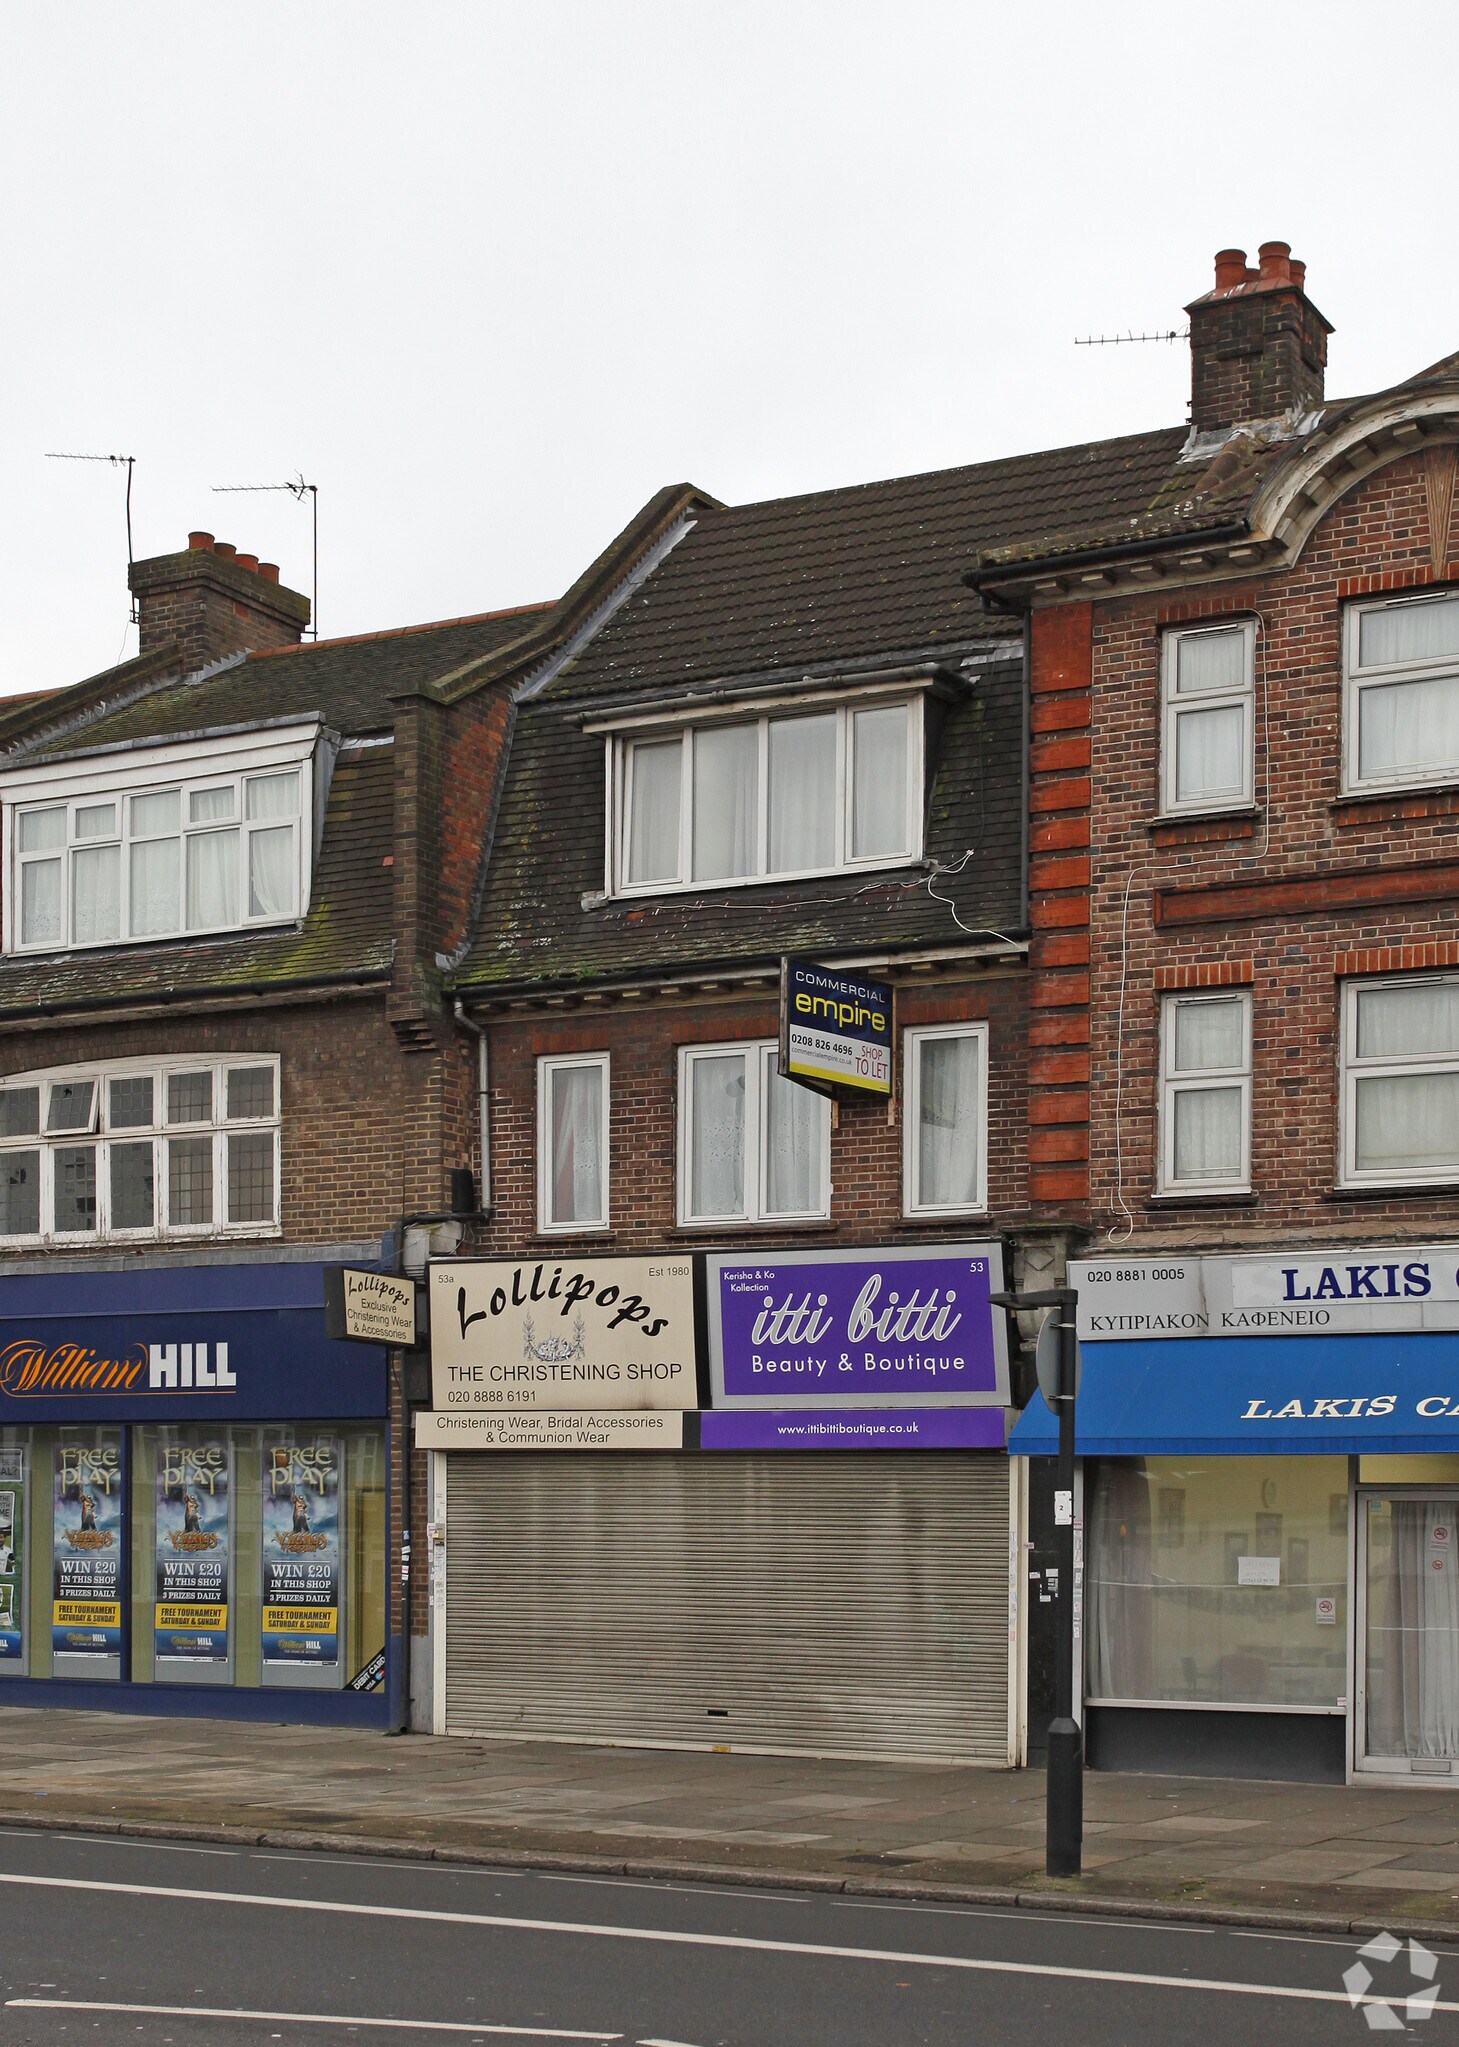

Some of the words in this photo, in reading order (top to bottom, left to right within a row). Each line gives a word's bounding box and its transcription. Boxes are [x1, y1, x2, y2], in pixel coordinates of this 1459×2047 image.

[795, 971, 885, 1003] COMMERCIAL
[795, 993, 885, 1031] empire
[791, 1033, 813, 1047] 0208
[815, 1039, 831, 1051] 826
[832, 1043, 853, 1056] 4696
[861, 1045, 883, 1060] SHOP
[855, 1057, 869, 1076] TO
[872, 1062, 888, 1080] LET
[648, 1267, 664, 1277] Est
[667, 1266, 690, 1276] 1980
[970, 1262, 984, 1273] 53
[438, 1274, 455, 1284] 53a
[723, 1271, 753, 1280] Kerisha
[755, 1270, 762, 1279] &
[764, 1270, 775, 1279] Ko
[1087, 1271, 1112, 1283] 020
[1116, 1269, 1147, 1282] 8881
[1152, 1268, 1185, 1281] 0005
[1281, 1262, 1431, 1302] LAKIS
[349, 1276, 410, 1306] Lollipops
[730, 1282, 769, 1292] Kollection
[361, 1298, 397, 1313] Exclusive
[457, 1264, 669, 1340] Lollipops
[751, 1293, 833, 1346] itti
[847, 1273, 962, 1344] bitti
[347, 1308, 389, 1327] Christening
[391, 1316, 412, 1328] Wear
[1090, 1313, 1210, 1331] ΚΥΠΡΙΑΚΟΝ
[1221, 1310, 1331, 1328] ΚΑΦΕΝΕΙΟ
[353, 1322, 359, 1332] &
[361, 1323, 407, 1339] Accessories
[0, 1340, 148, 1392] William
[149, 1342, 237, 1388] HILL
[751, 1354, 828, 1377] Beauty
[838, 1353, 853, 1371] &
[865, 1352, 965, 1376] Boutique
[448, 1365, 484, 1382] THE
[489, 1364, 621, 1382] CHRISTENING
[627, 1363, 682, 1380] SHOP
[447, 1391, 470, 1403] 020
[473, 1390, 503, 1402] 8888
[507, 1390, 536, 1402] 6191
[1240, 1395, 1398, 1420] LAKIS
[436, 1416, 504, 1431] Christening
[508, 1417, 543, 1430] Wear,
[548, 1416, 583, 1428] Bridal
[587, 1416, 664, 1429] Accessories
[777, 1422, 919, 1436] www.ittibittiboutique.co.uk
[485, 1432, 495, 1443] &
[498, 1432, 573, 1443] Communion
[574, 1432, 610, 1443] Wear
[61, 1448, 118, 1469] FREE
[163, 1448, 223, 1469] FREE
[270, 1446, 332, 1468] FREE
[0, 1467, 17, 1476] AL?
[60, 1465, 119, 1495] PLAY
[163, 1465, 223, 1495] PLAY
[269, 1465, 333, 1495] PLAY
[61, 1560, 91, 1573] WIN
[95, 1561, 116, 1574] £20
[164, 1562, 195, 1575] WIN
[199, 1563, 221, 1576] £20
[271, 1564, 303, 1577] WIN
[308, 1565, 331, 1578] £20
[61, 1575, 71, 1583] IN
[72, 1575, 92, 1584] THIS
[93, 1576, 116, 1584] SHOP
[164, 1578, 174, 1586] IN
[175, 1578, 196, 1586] THIS
[197, 1578, 221, 1587] SHOP
[283, 1580, 305, 1588] THIS
[306, 1580, 331, 1589] SHOP
[65, 1589, 92, 1597] PRIZES
[197, 1592, 221, 1600] DAILY
[275, 1594, 304, 1602] PRIZES
[59, 1605, 73, 1613] FREE
[74, 1606, 116, 1614] TOURNAMENT
[161, 1608, 176, 1616] FREE
[177, 1608, 222, 1617] TOURNAMENT
[268, 1611, 284, 1619] FREE
[285, 1611, 331, 1620] TOURNAMENT
[58, 1614, 86, 1622] SATURDAY
[87, 1614, 92, 1622] &
[93, 1615, 115, 1623] SUNDAY
[160, 1617, 190, 1625] SATURDAY
[191, 1617, 196, 1625] &
[268, 1620, 298, 1628] SATURDAY
[299, 1620, 305, 1628] &
[92, 1634, 106, 1642] HILL
[197, 1637, 212, 1646] HILL
[305, 1640, 321, 1649] HILL
[353, 1672, 370, 1690] DEBIT
[369, 1656, 385, 1674] CARD
[364, 1679, 376, 1690] VISA
